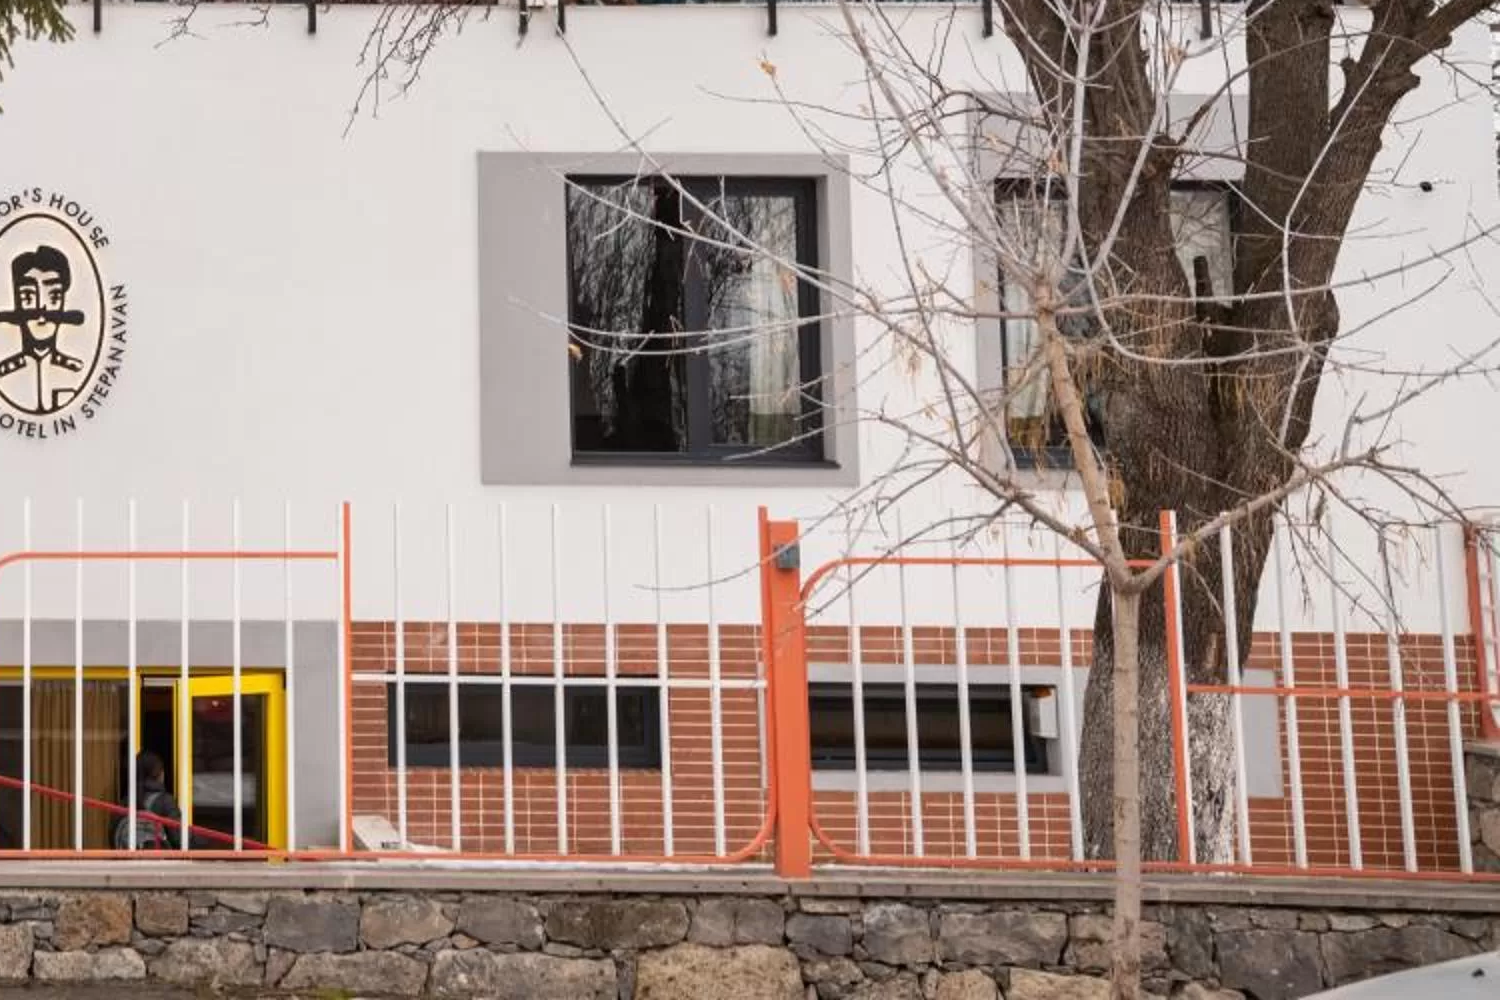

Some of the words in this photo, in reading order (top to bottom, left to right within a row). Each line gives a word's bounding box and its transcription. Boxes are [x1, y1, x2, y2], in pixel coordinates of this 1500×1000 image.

[49, 193, 109, 250] HOUSE
[53, 415, 77, 436] IN
[81, 284, 128, 420] STEPANAVAN
